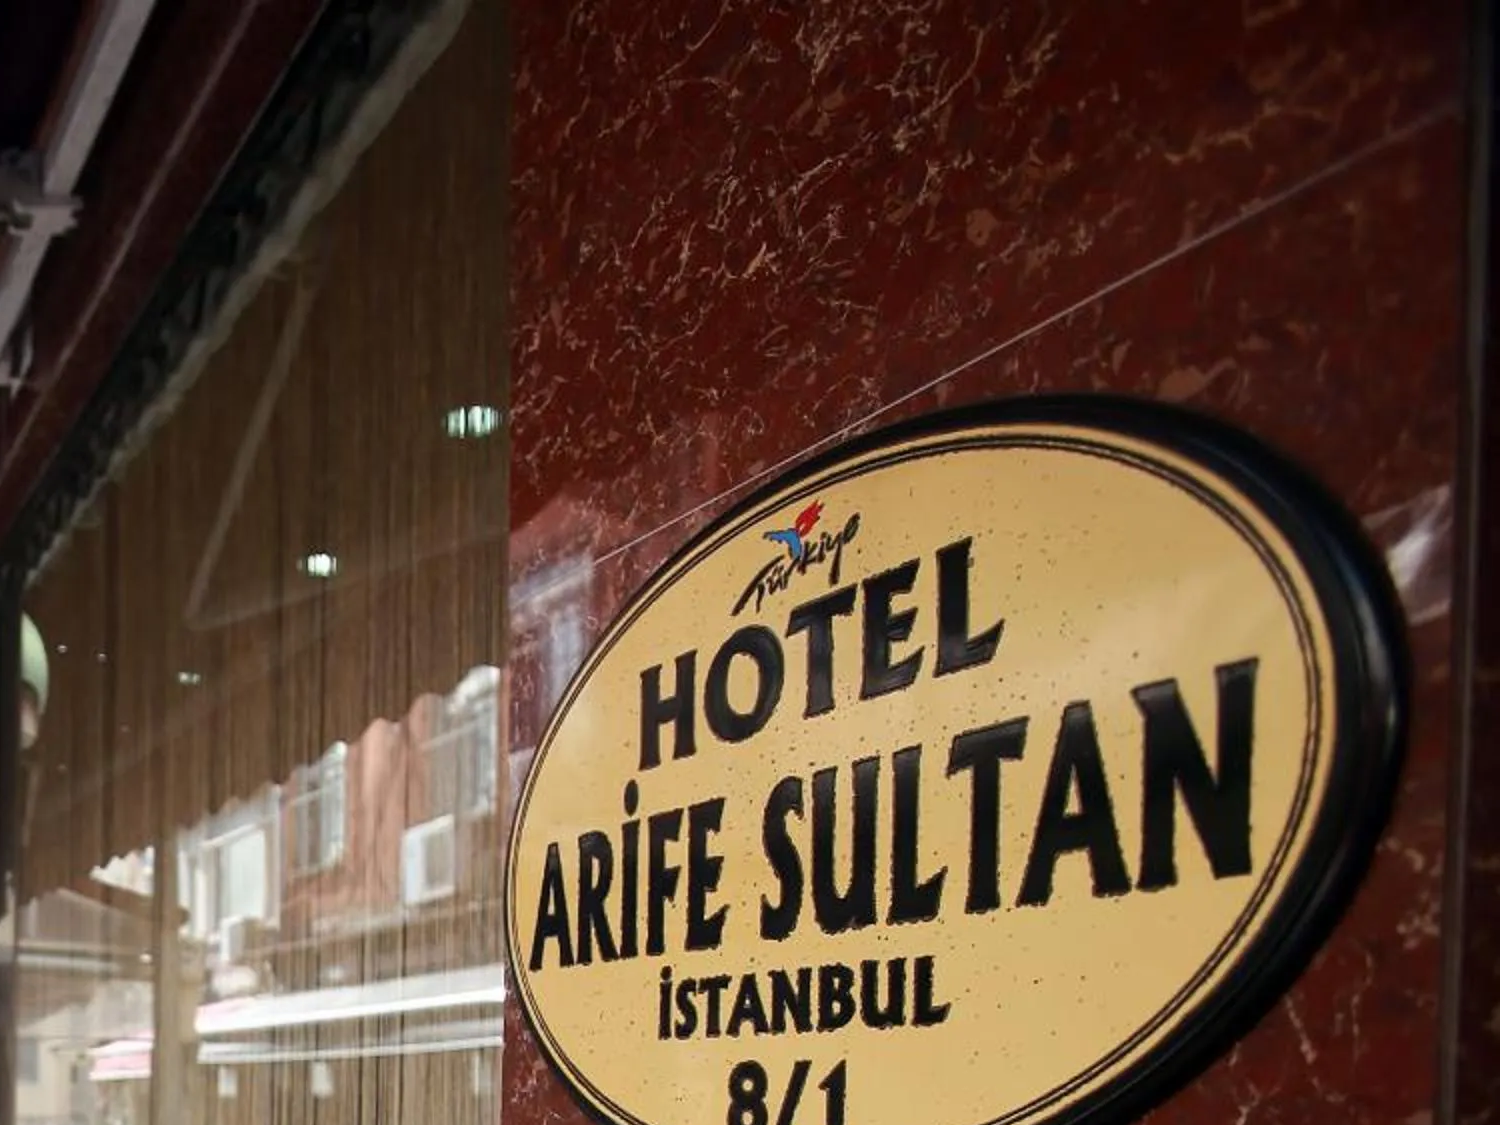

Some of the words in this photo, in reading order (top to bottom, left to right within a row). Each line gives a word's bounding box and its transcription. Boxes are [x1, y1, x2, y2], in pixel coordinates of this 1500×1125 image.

[730, 511, 861, 616] Türkiye
[638, 537, 1004, 771] HOTEL
[529, 780, 726, 971] ARİFE
[760, 657, 1260, 943] SULTAN
[658, 956, 951, 1040] İSTANBUL
